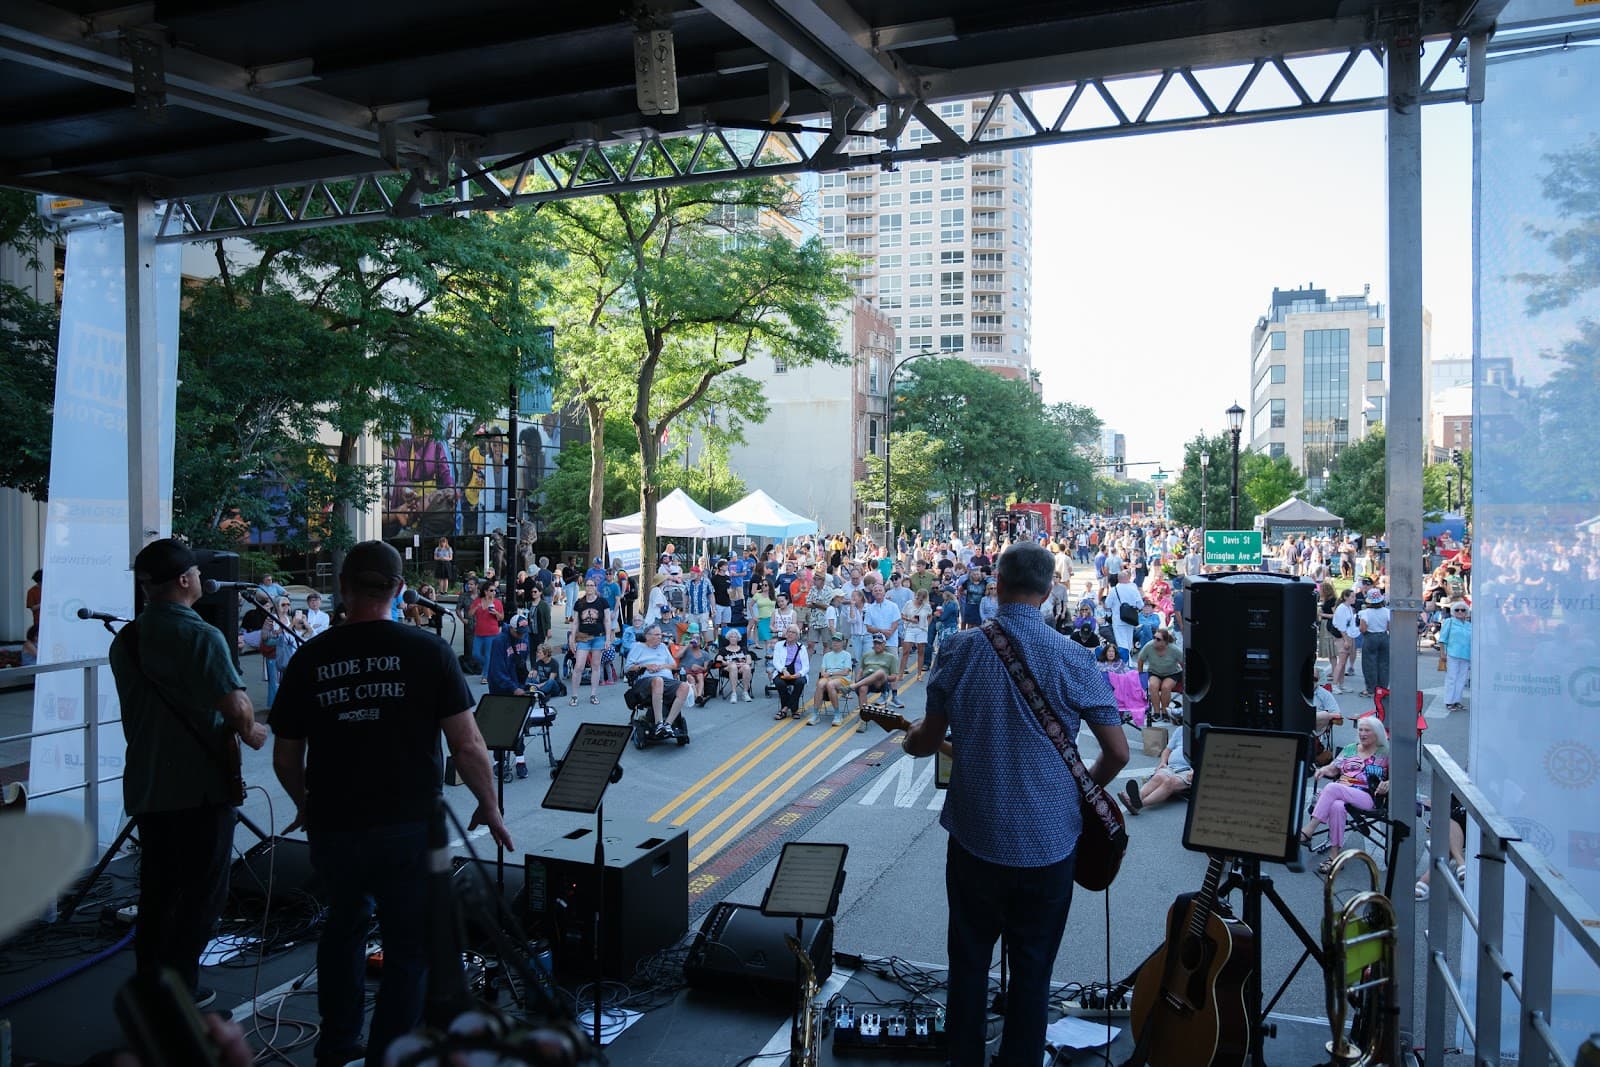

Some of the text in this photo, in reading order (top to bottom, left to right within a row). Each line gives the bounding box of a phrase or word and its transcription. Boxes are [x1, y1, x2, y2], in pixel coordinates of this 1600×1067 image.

[1223, 536, 1250, 545] Davis St
[1206, 552, 1250, 562] Orrington Ave
[316, 655, 401, 682] RIDE FOR
[316, 682, 406, 707] THE CURE
